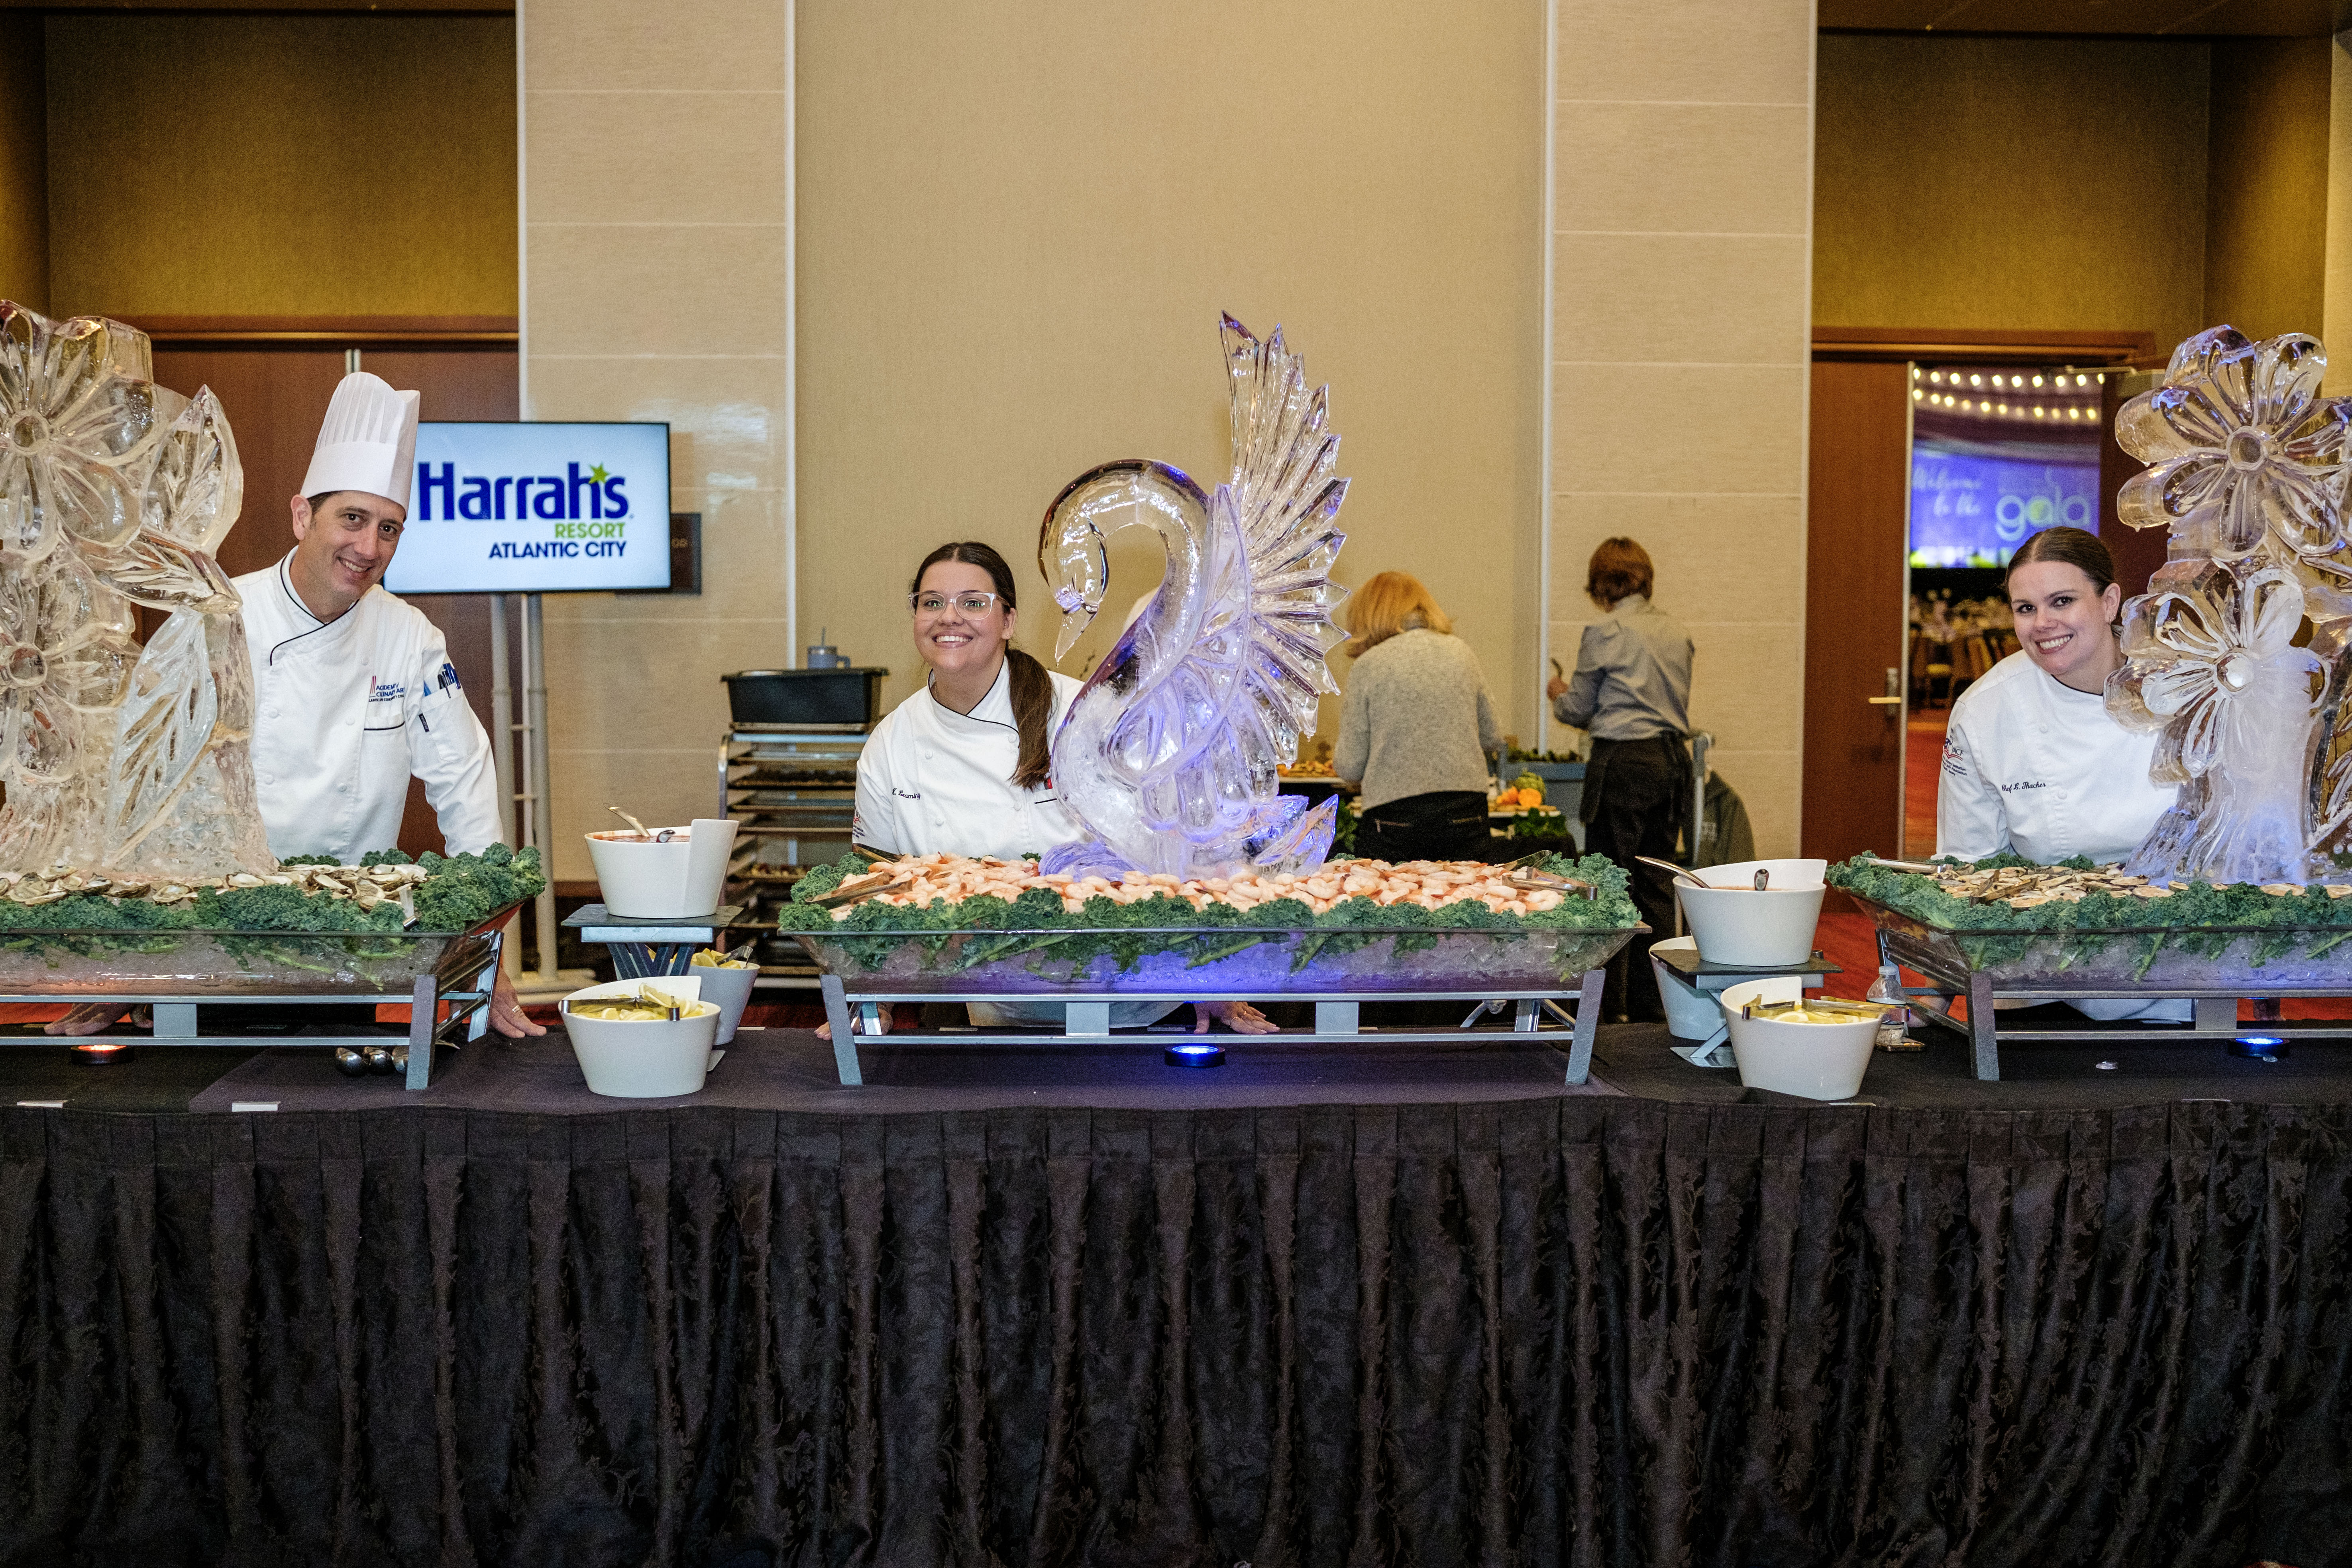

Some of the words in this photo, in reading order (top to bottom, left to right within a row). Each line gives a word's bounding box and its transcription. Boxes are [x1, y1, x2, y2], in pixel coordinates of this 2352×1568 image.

[1995, 467, 2091, 542] gala
[555, 522, 625, 538] RESORT
[489, 541, 579, 558] ATLANTIC
[585, 541, 626, 557] CITY
[2001, 784, 2012, 793] Chef
[2022, 781, 2046, 789] Thacker
